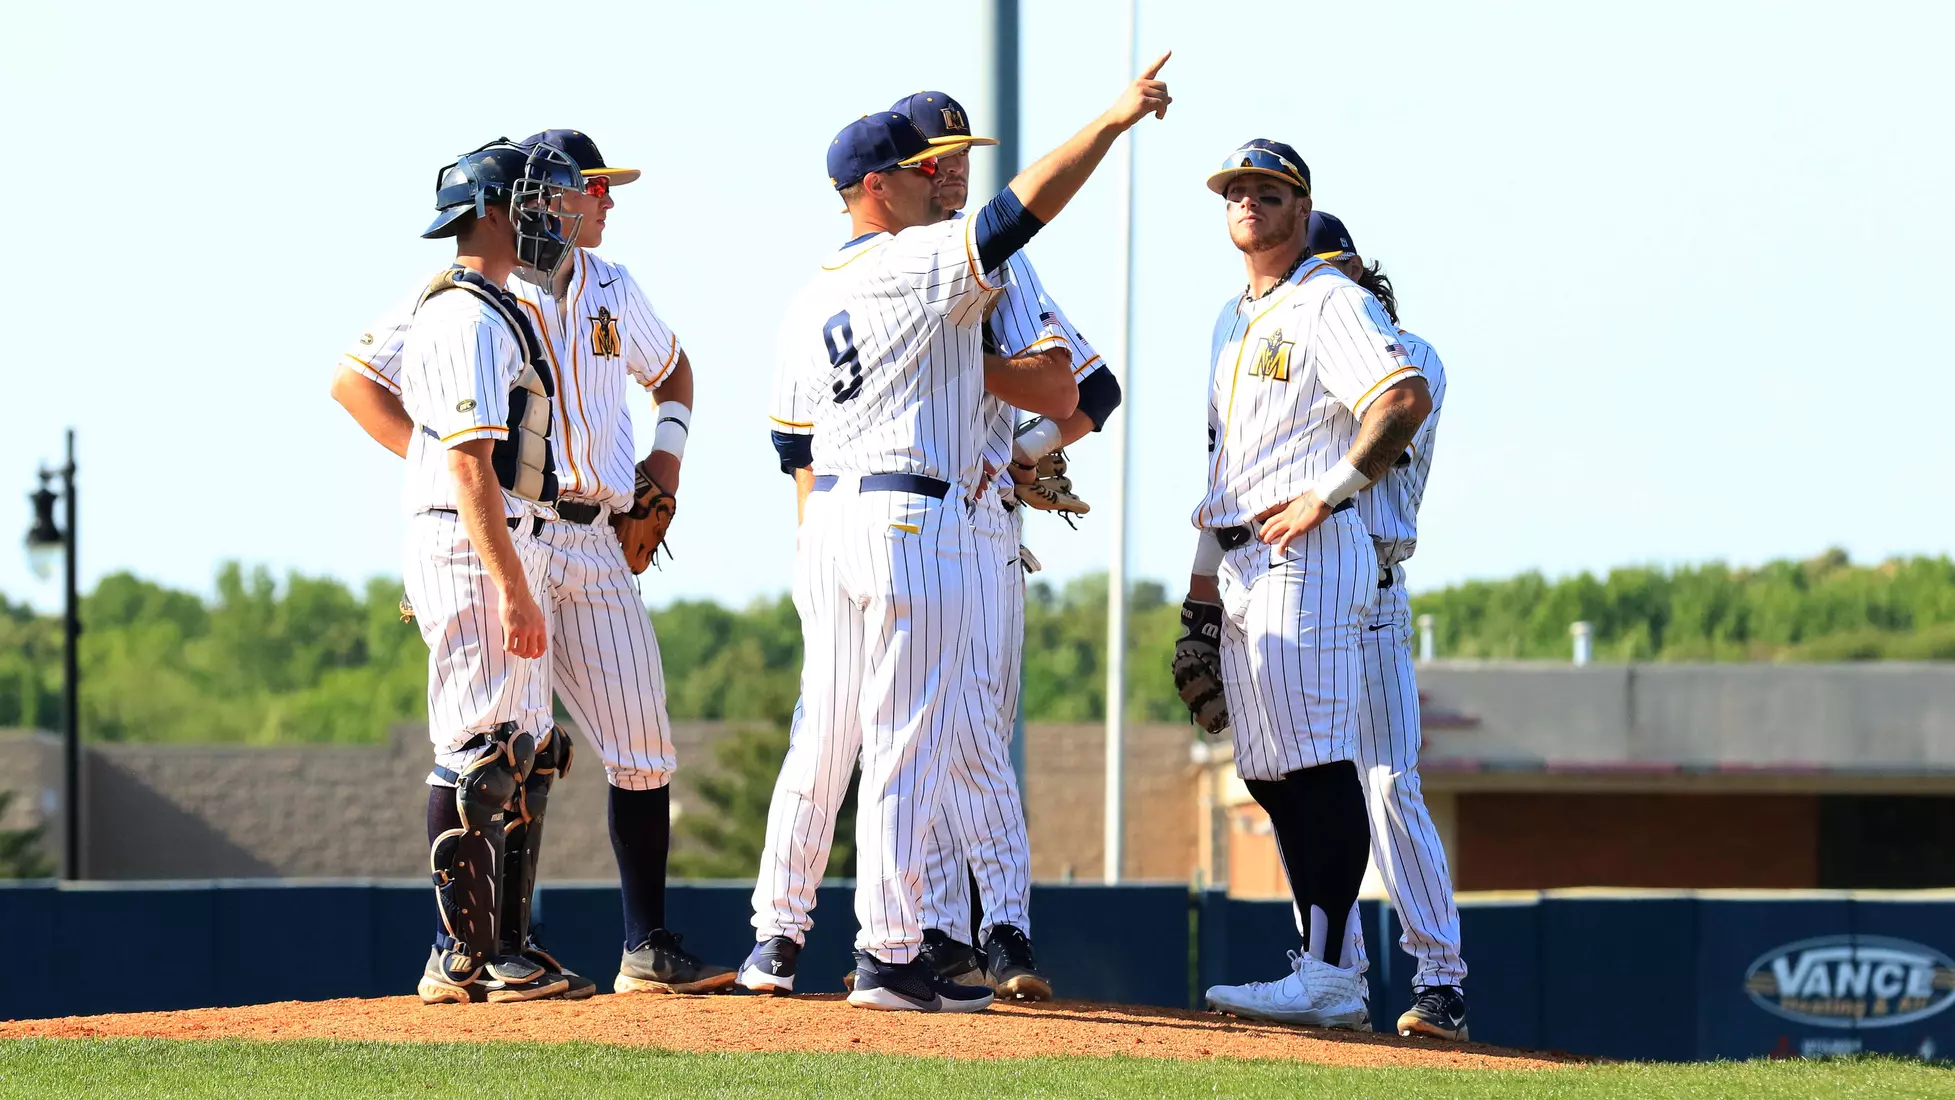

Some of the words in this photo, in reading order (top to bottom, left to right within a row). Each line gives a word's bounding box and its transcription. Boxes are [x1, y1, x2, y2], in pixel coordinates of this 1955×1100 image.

[822, 308, 863, 405] 9
[1247, 336, 1296, 383] M
[1773, 948, 1937, 998] VANCE
